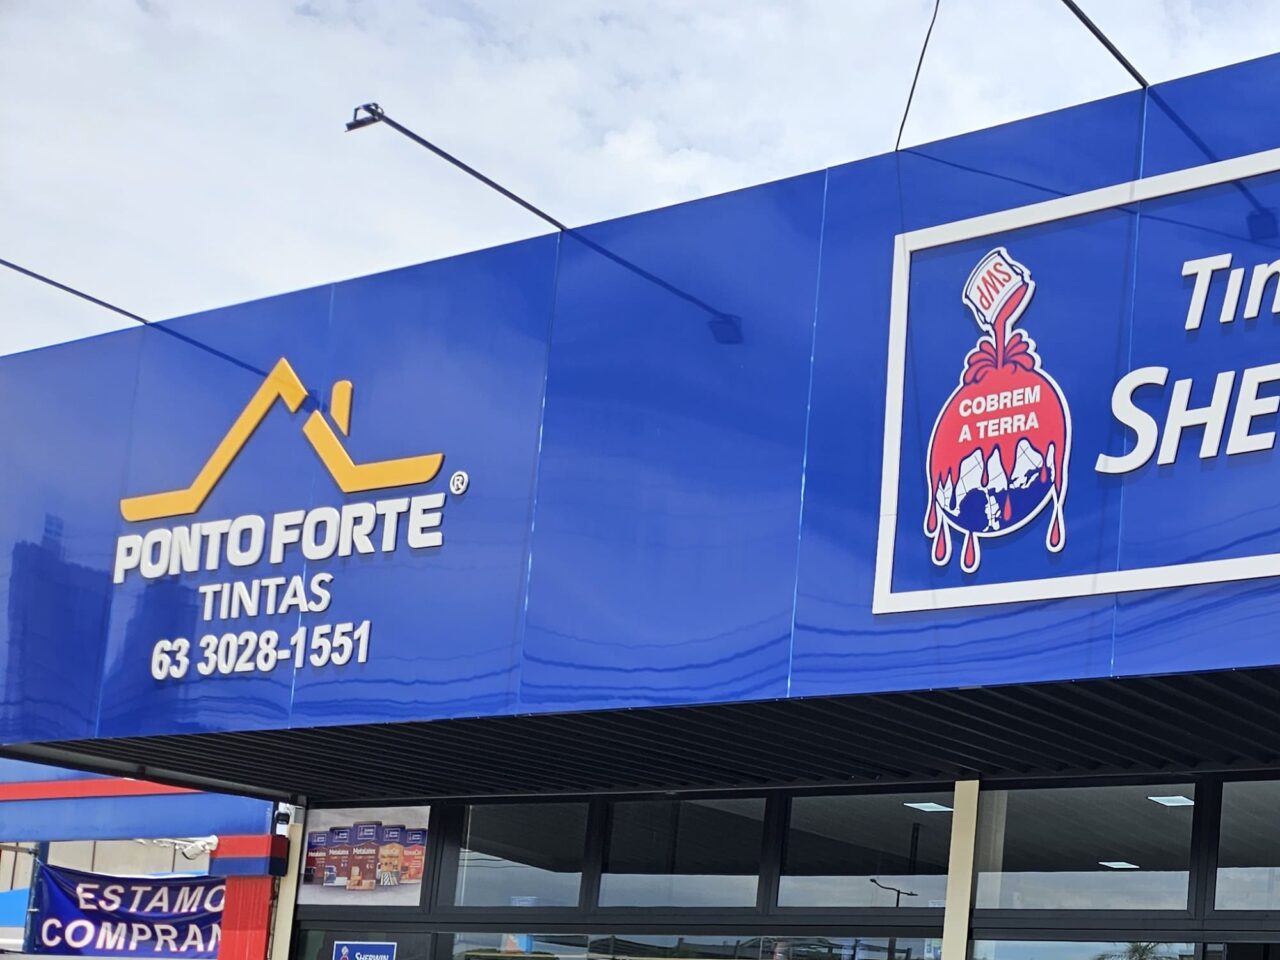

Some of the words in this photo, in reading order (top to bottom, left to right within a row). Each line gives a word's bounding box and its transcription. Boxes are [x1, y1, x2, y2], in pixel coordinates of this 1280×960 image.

[977, 262, 1012, 310] SWP
[958, 384, 1041, 417] COBREM
[958, 424, 972, 443] A
[976, 411, 1039, 439] TERRA
[113, 514, 266, 584] PONTO
[269, 492, 446, 564] FORTE
[198, 573, 334, 622] TINTAS
[151, 637, 190, 681] 63
[197, 620, 372, 676] 3028-1551
